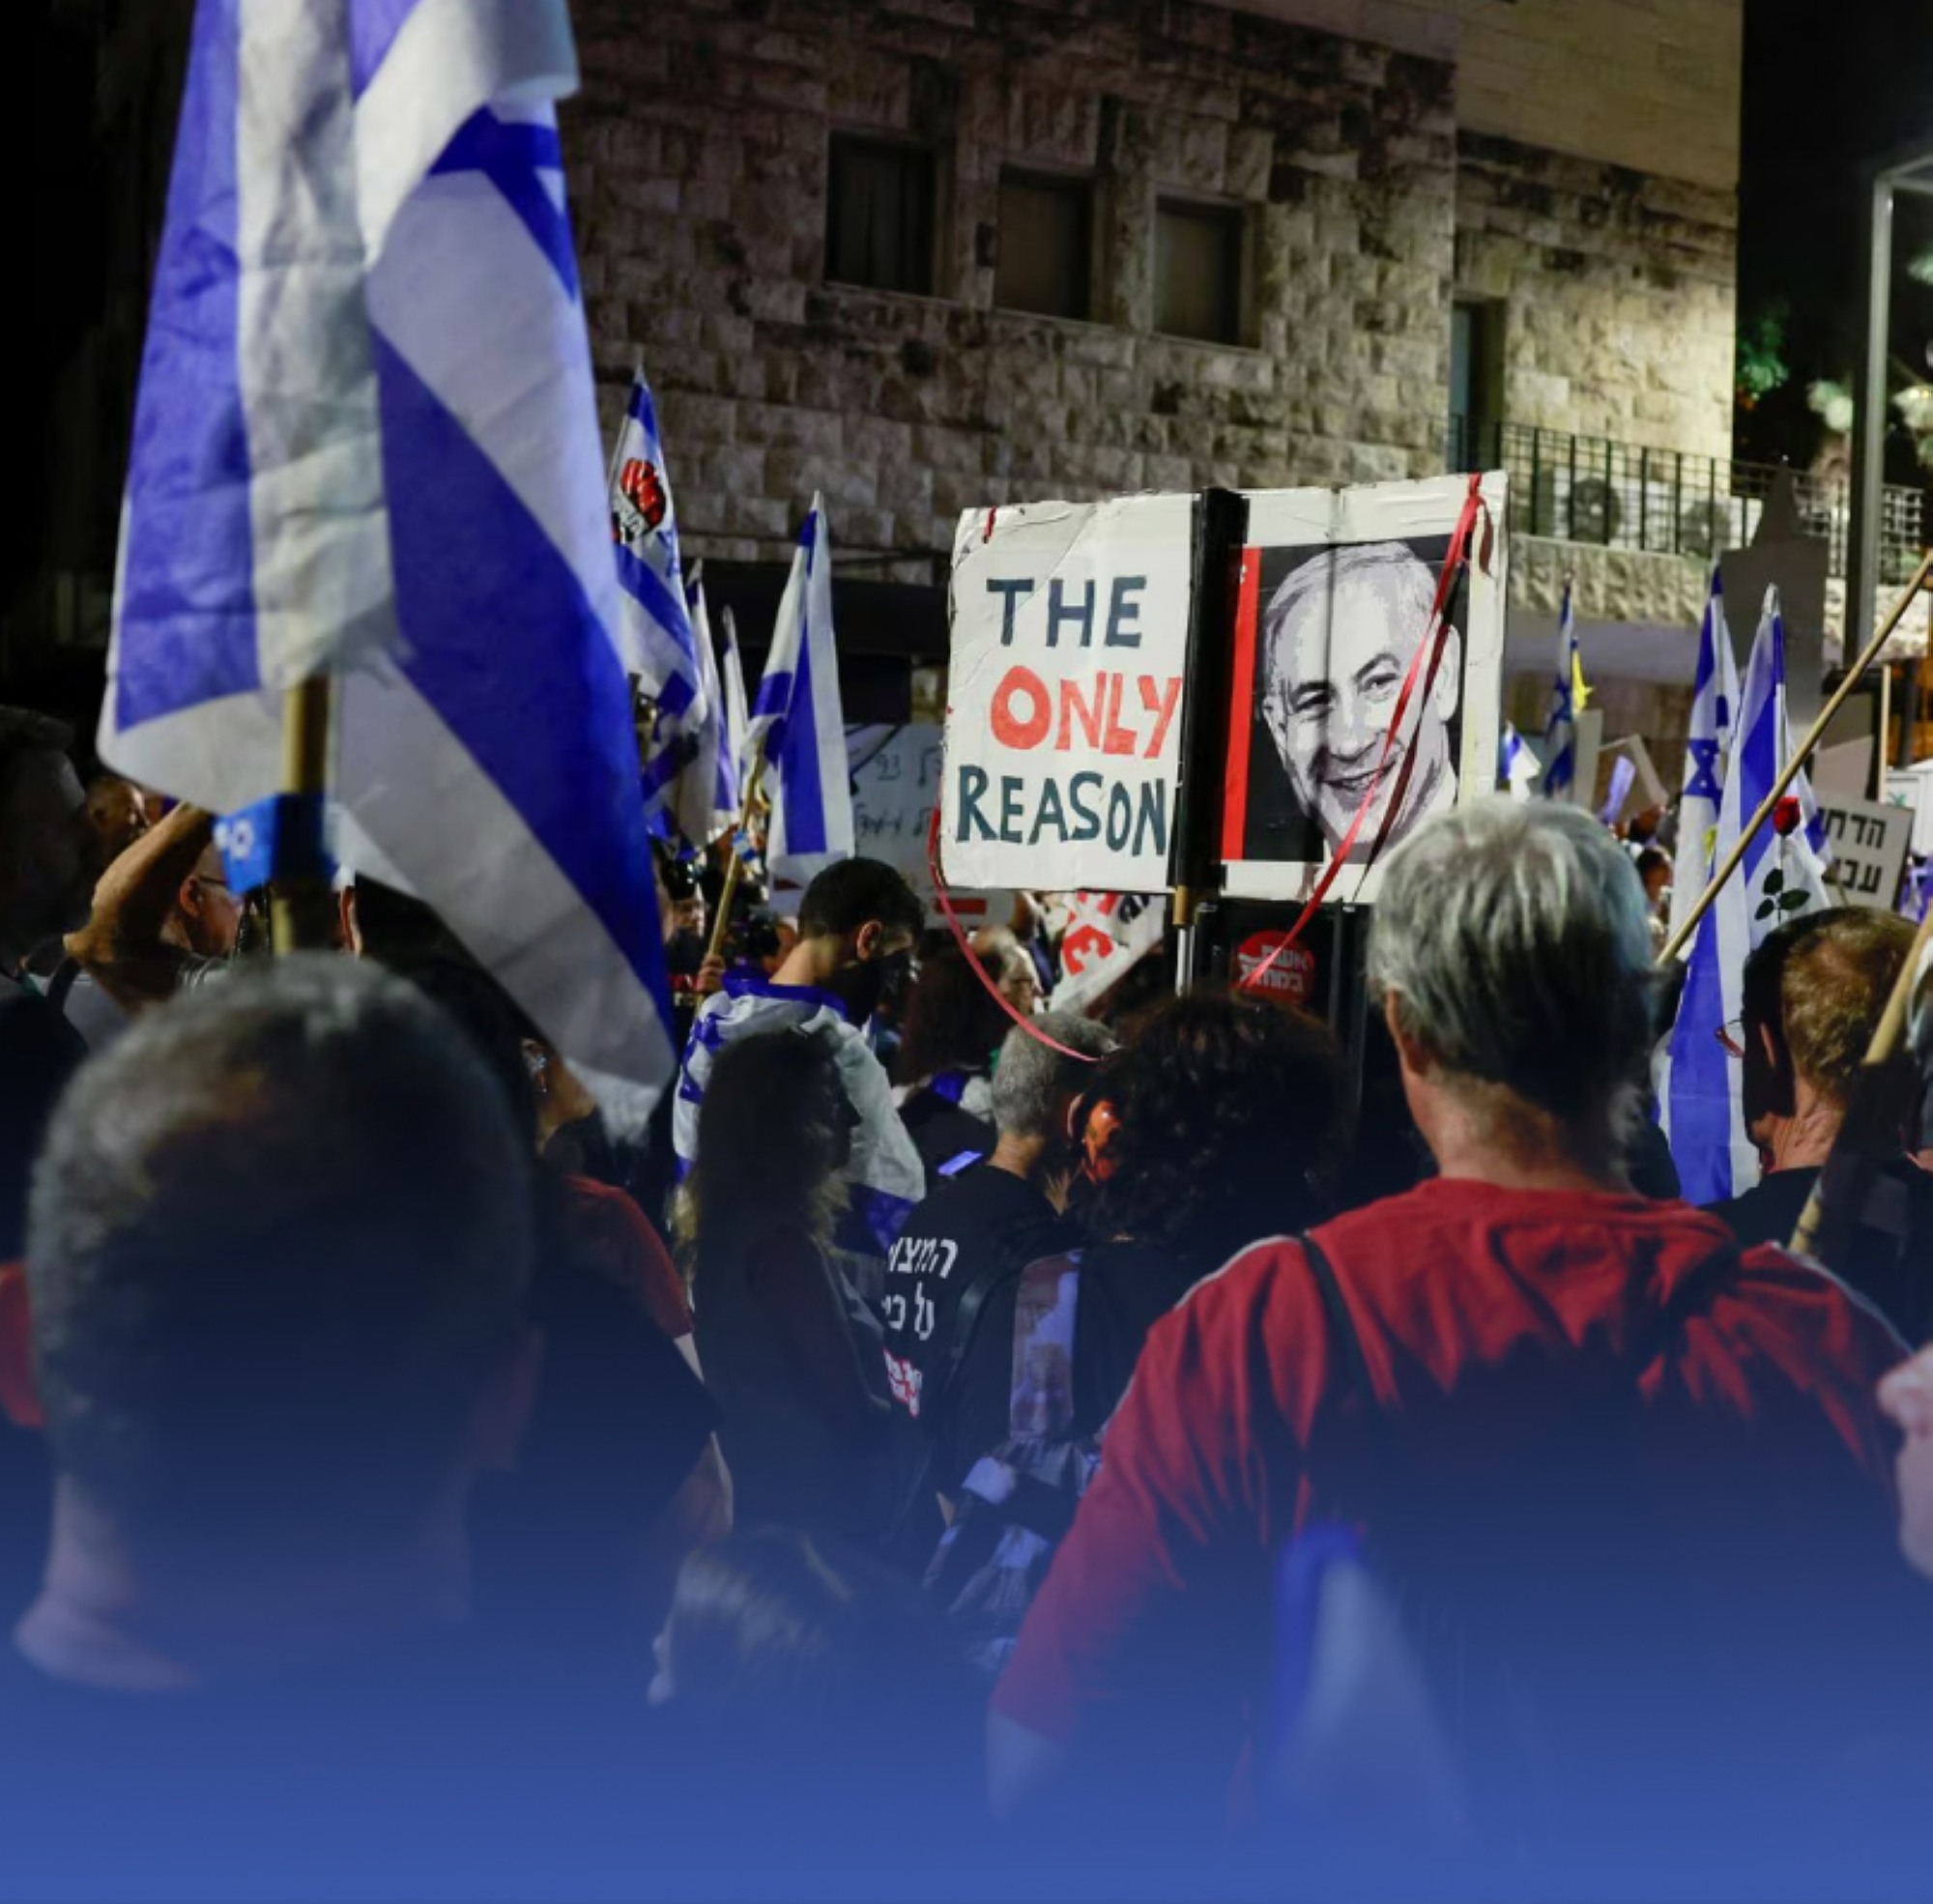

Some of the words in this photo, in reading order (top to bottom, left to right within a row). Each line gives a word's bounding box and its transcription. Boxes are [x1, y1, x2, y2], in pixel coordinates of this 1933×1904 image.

[987, 575, 1146, 649] THE
[991, 665, 1183, 760] ONLY
[956, 764, 1167, 858] REASON
